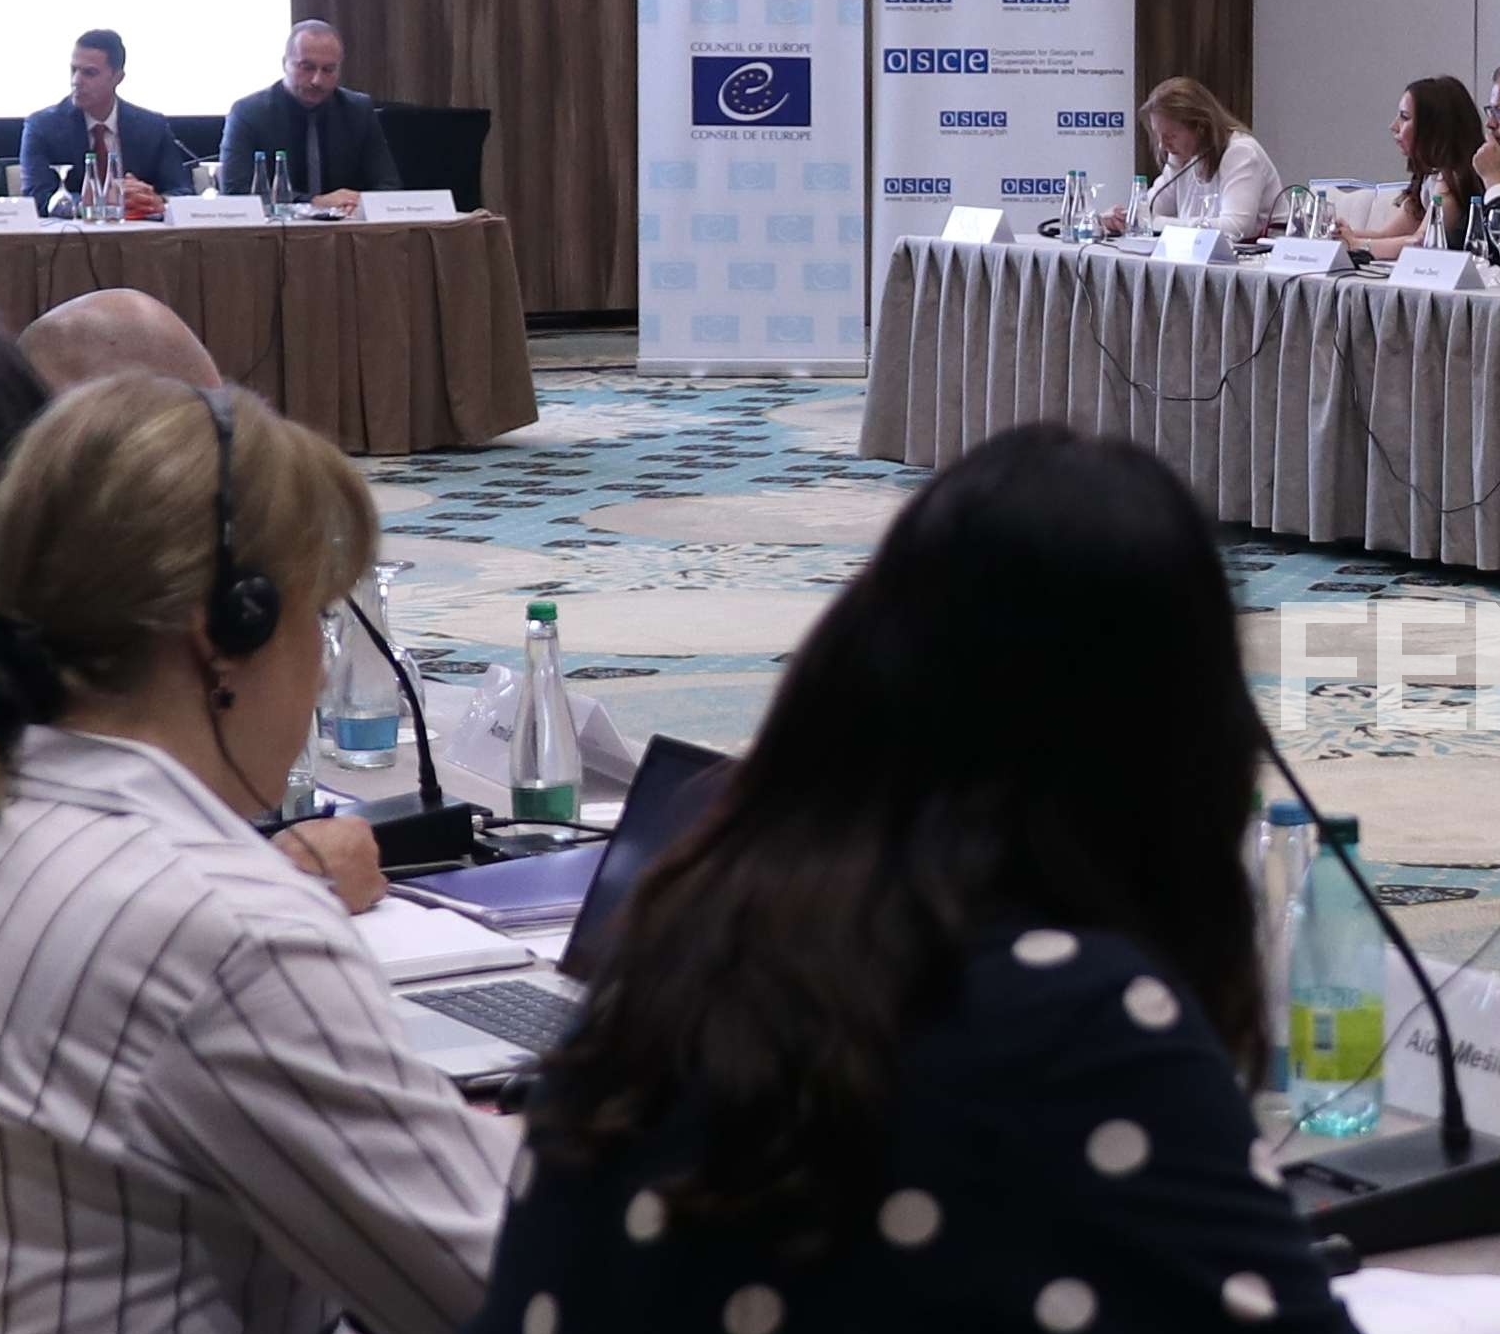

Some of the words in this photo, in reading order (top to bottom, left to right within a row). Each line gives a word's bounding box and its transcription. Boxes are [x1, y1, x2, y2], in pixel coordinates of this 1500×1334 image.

[690, 42, 744, 53] COUNCIL
[747, 42, 764, 53] OF
[768, 43, 811, 54] EUROPE
[884, 49, 989, 73] osce
[941, 111, 1007, 127] osce
[1058, 112, 1124, 127] osce
[690, 129, 739, 141] CONSEIL
[743, 129, 757, 141] DE
[885, 178, 951, 194] osce
[1002, 179, 1065, 194] osce
